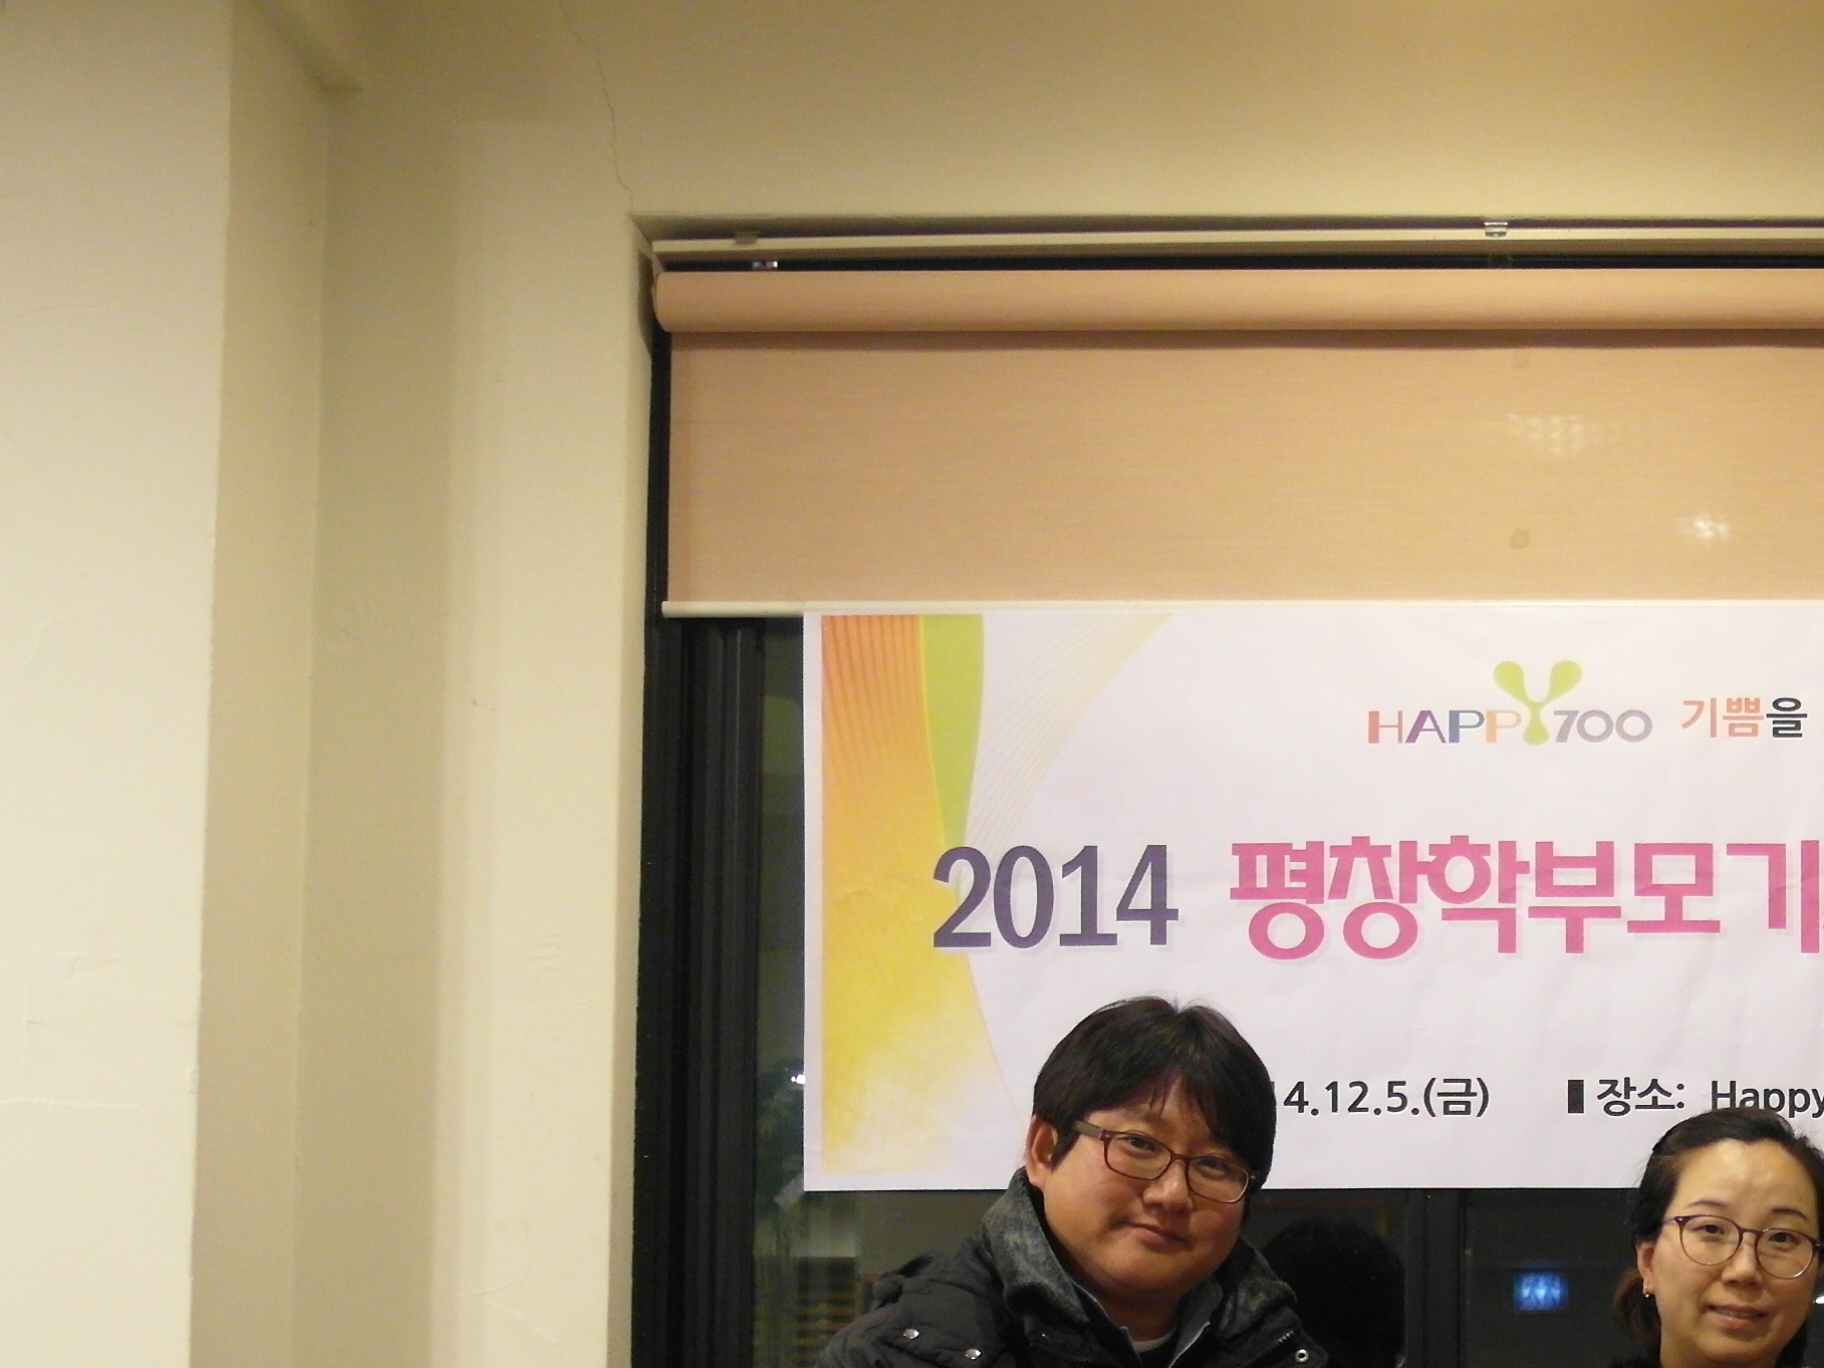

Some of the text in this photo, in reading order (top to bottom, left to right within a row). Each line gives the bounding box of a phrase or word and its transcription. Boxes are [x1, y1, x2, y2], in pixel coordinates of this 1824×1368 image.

[1681, 696, 1808, 740] 기쁨을
[931, 843, 1180, 951] 2014
[1271, 1077, 1490, 1118] 4.12.5.(금)
[1597, 1076, 1685, 1117] 장소:
